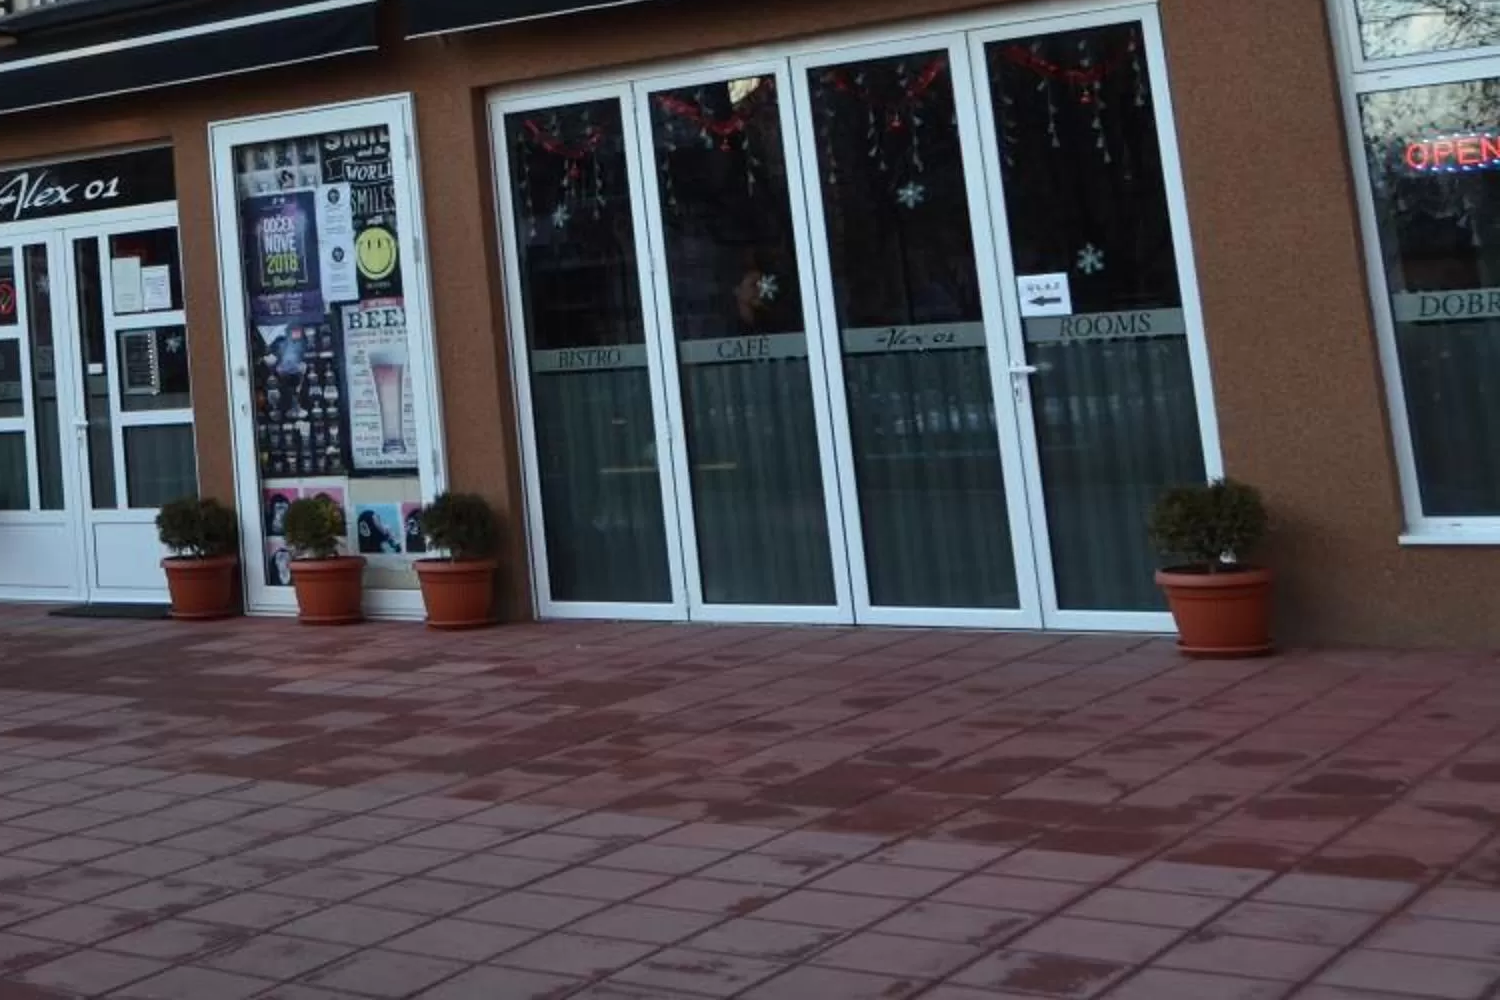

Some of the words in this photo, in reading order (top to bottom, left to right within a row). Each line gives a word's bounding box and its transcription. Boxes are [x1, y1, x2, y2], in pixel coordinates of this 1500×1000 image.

[1406, 136, 1500, 167] OPEN
[84, 176, 120, 200] 01
[264, 231, 297, 254] NOVE
[266, 253, 299, 275] 2018
[558, 350, 621, 369] BISTRO
[1059, 312, 1152, 338] ROOMS
